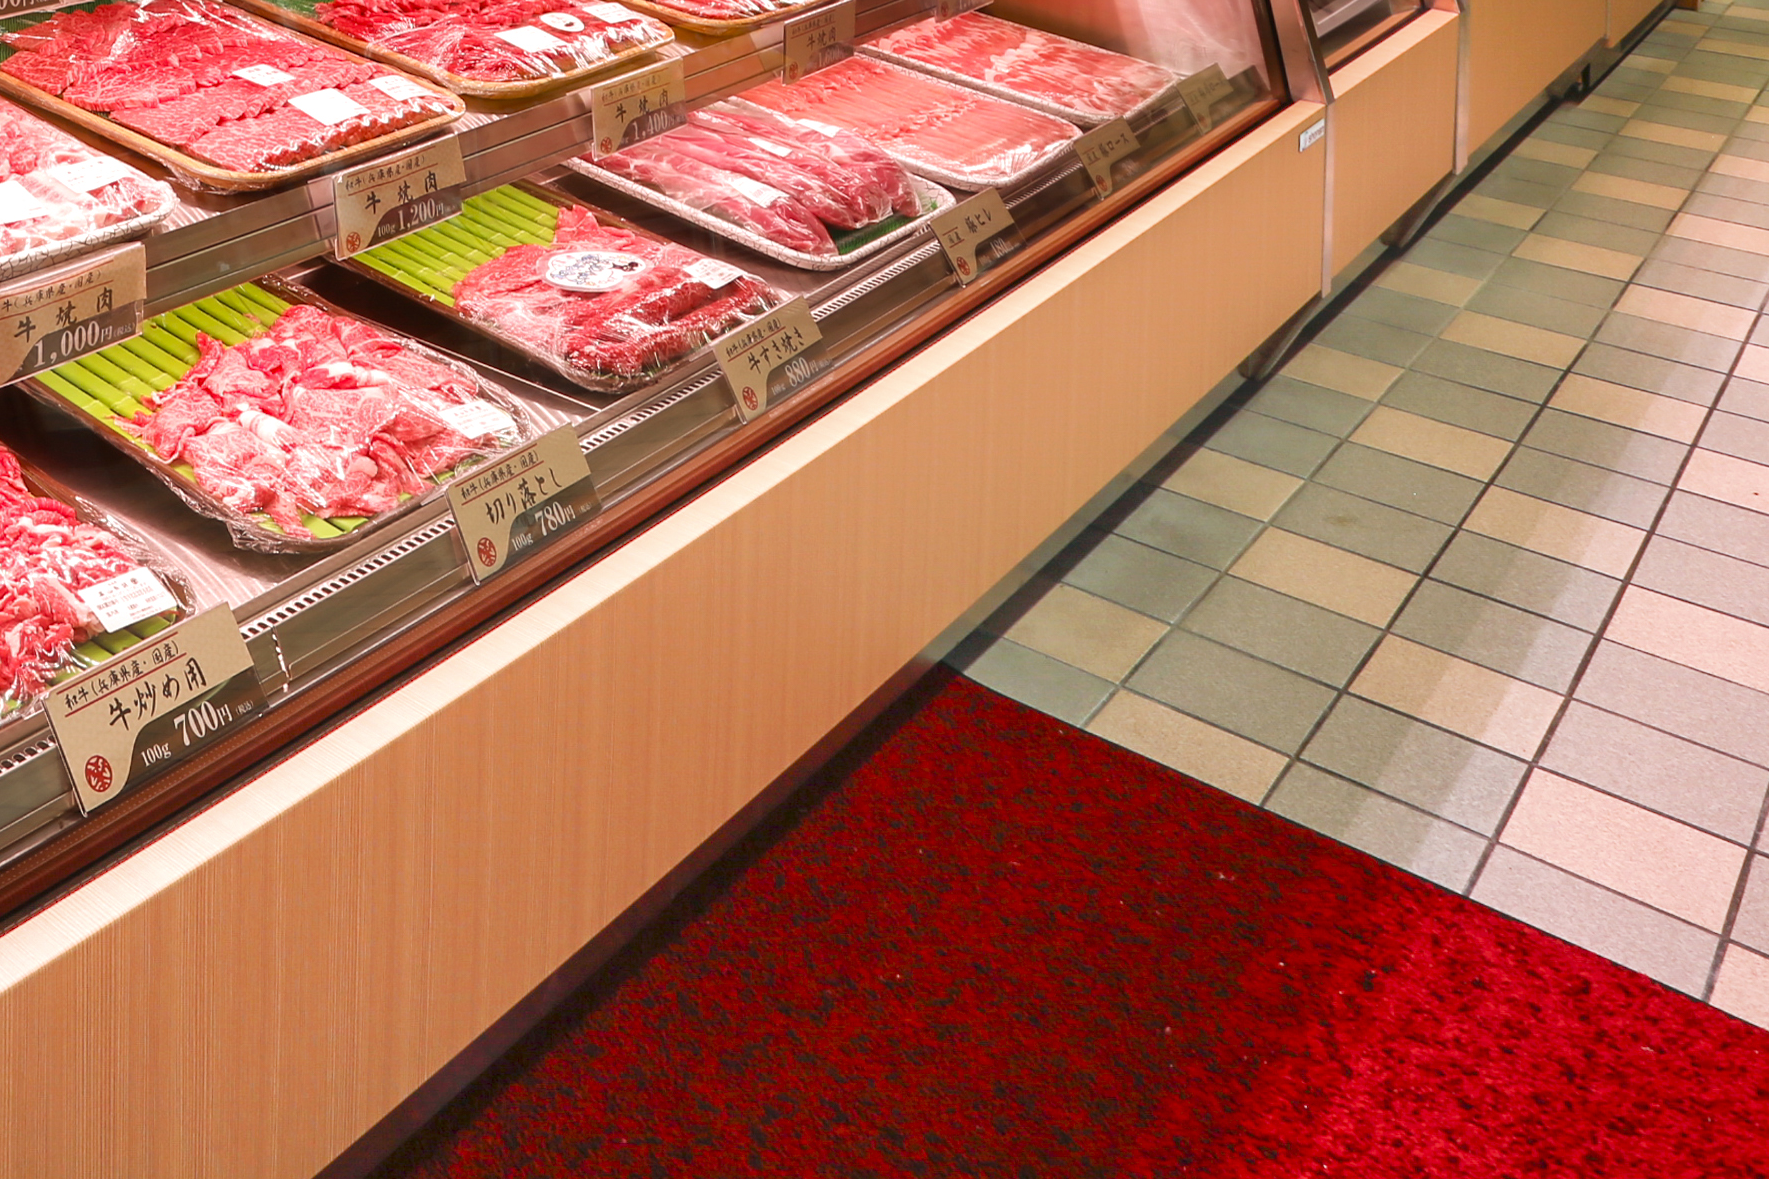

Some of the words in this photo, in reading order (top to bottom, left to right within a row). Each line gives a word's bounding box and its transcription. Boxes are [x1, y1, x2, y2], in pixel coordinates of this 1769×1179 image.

[365, 170, 439, 214] 牛焼肉
[14, 286, 114, 343] 牛焼肉
[748, 326, 805, 374] 牛すき焼き
[485, 468, 562, 525] 切り落とし
[511, 534, 534, 551] 100g
[534, 501, 576, 536] 780円
[109, 657, 207, 731] 牛炒め用
[141, 742, 171, 767] 100g
[173, 700, 233, 746] 700円
